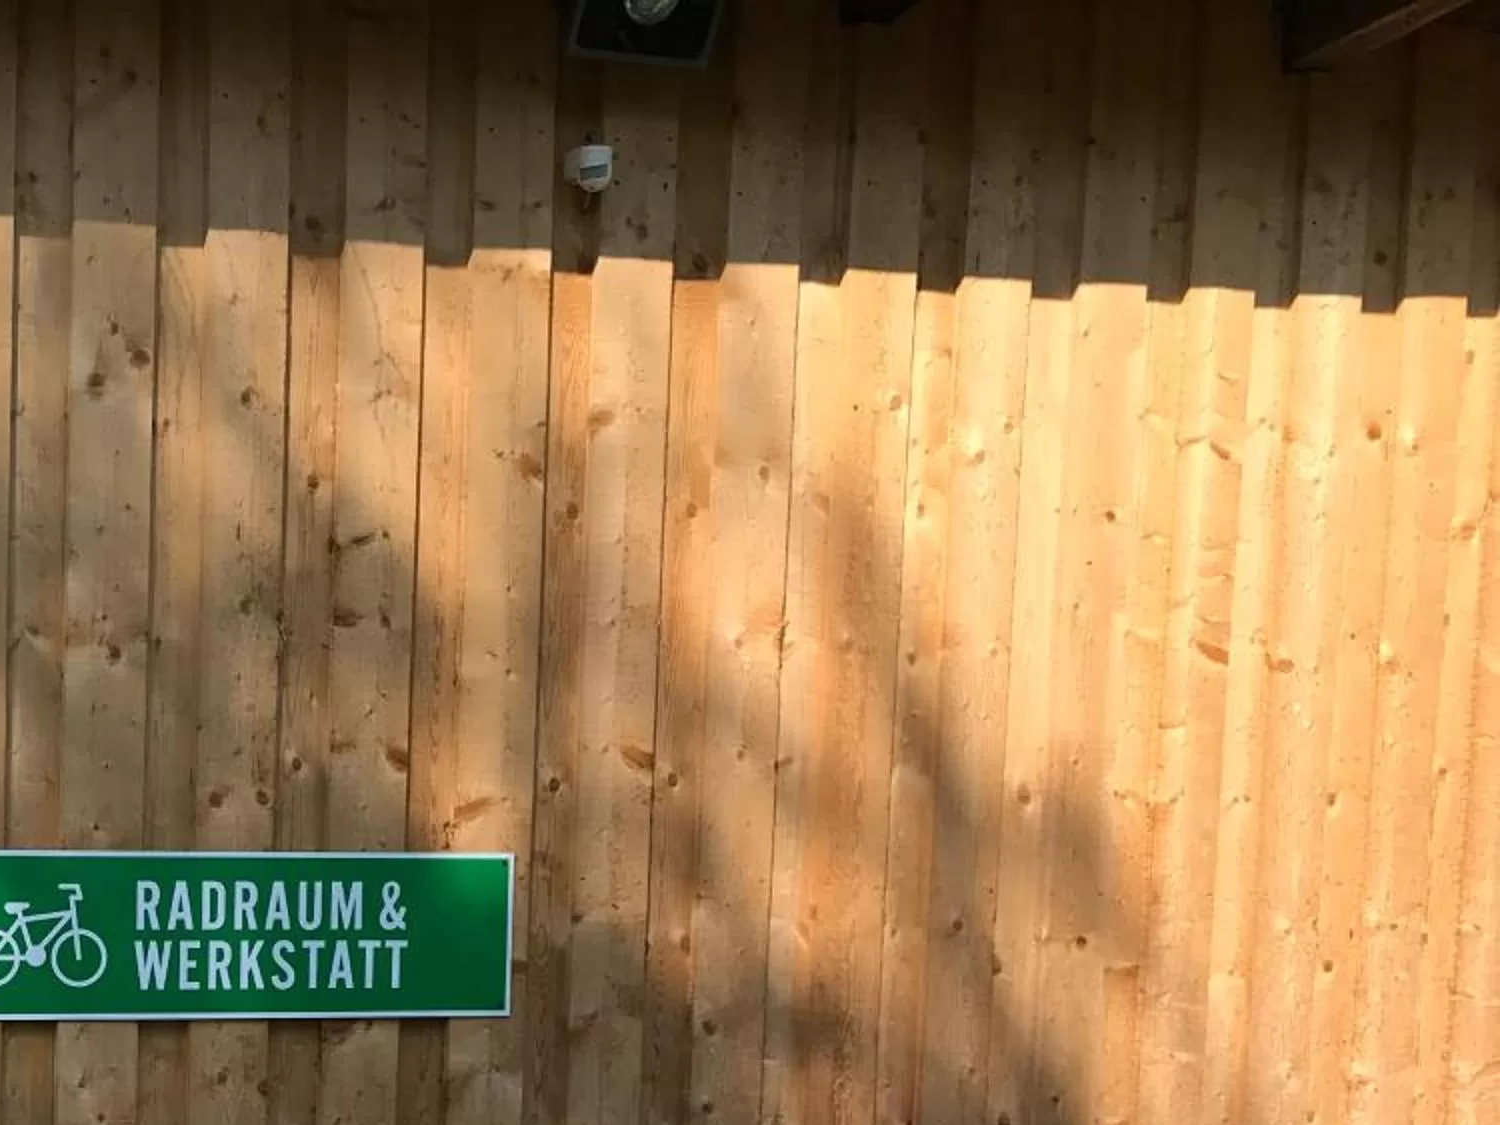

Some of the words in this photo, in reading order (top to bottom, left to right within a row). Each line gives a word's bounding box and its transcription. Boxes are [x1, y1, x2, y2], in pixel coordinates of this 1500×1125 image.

[135, 880, 364, 931] RADRAUM
[379, 881, 407, 931] &
[134, 939, 409, 991] WERKSTATT
